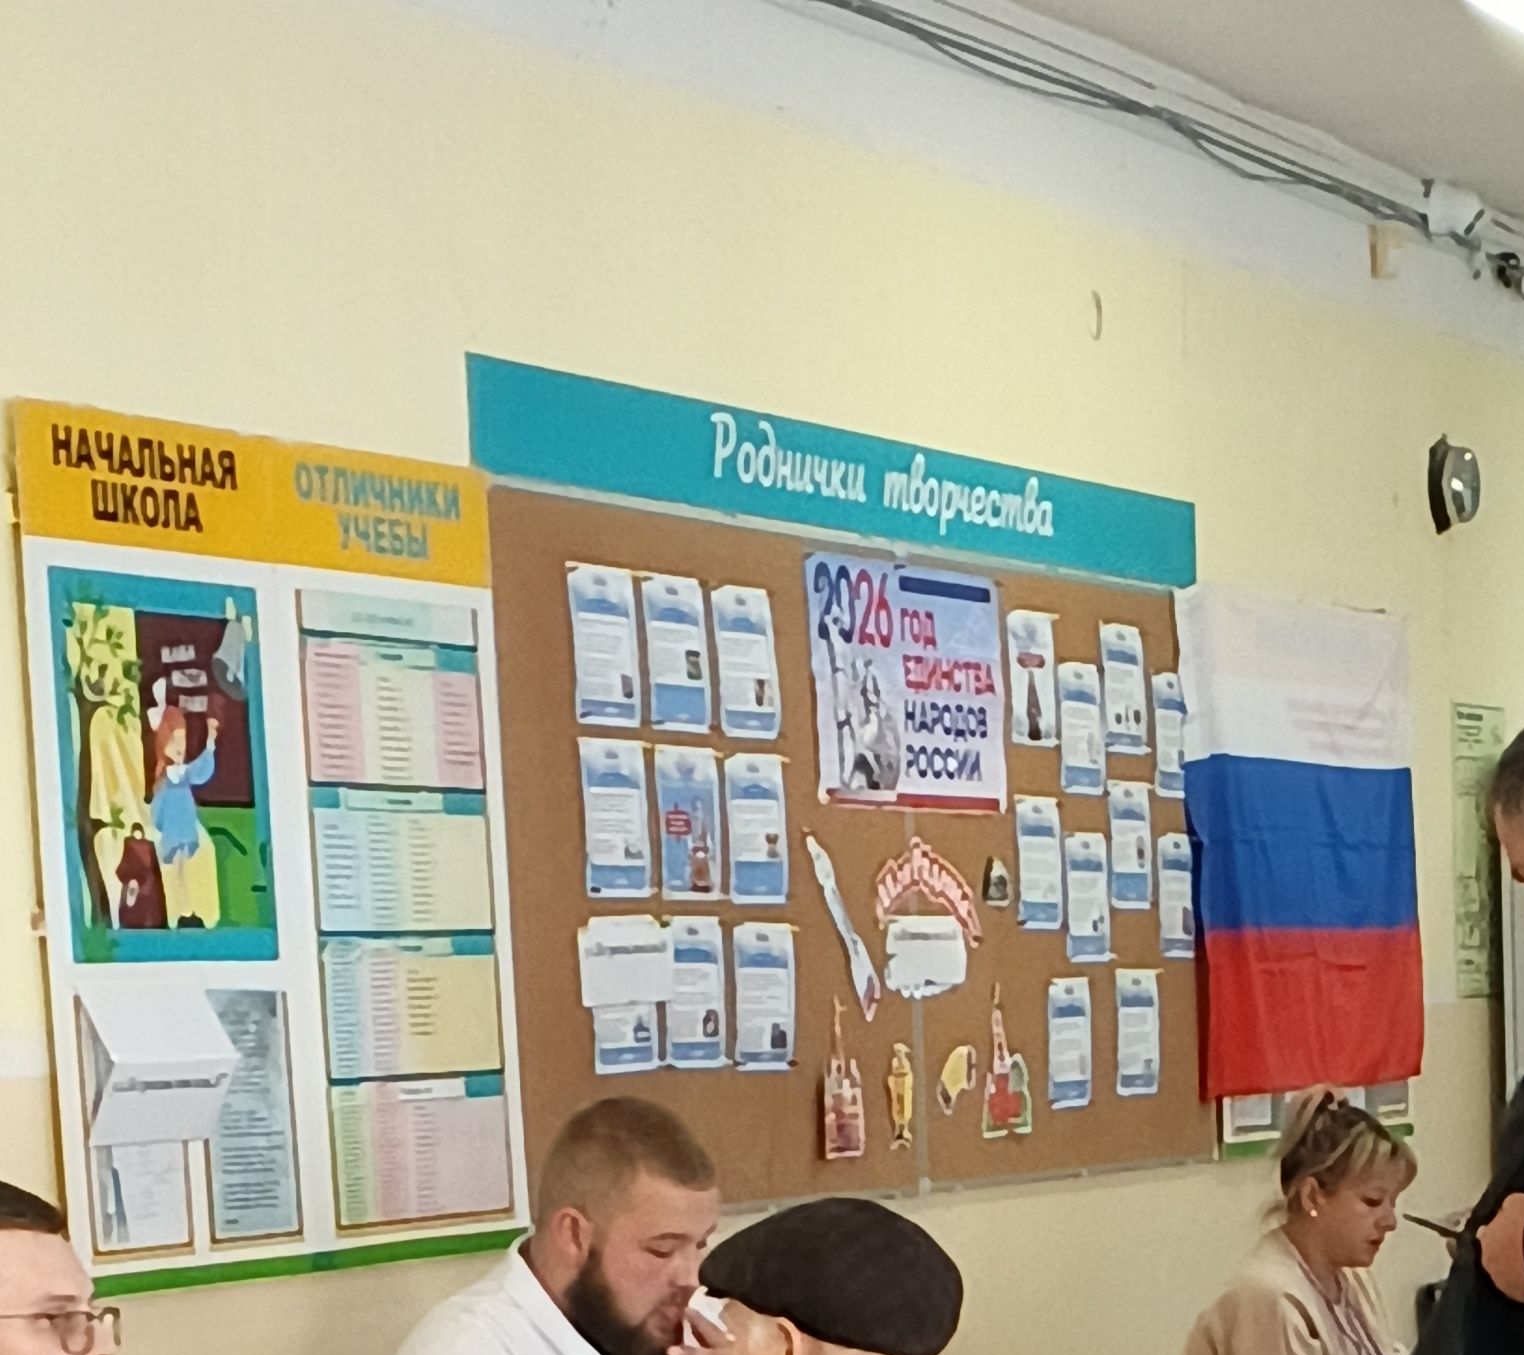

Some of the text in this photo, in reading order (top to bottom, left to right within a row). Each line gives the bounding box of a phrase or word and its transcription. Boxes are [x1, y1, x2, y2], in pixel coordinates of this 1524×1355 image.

[51, 424, 238, 491] НАЧАЛЬНАЯ
[711, 412, 1054, 537] Роднички творчества
[91, 478, 204, 534] ШКОЛА
[293, 462, 461, 521] ОТЛИЧНИКИ
[338, 513, 429, 560] УЧЕБЫ
[813, 560, 894, 648] 2026
[902, 653, 997, 696] ЕДИНСТВА
[904, 698, 988, 743] НАРОДОВ
[904, 744, 983, 782] РОССИИ
